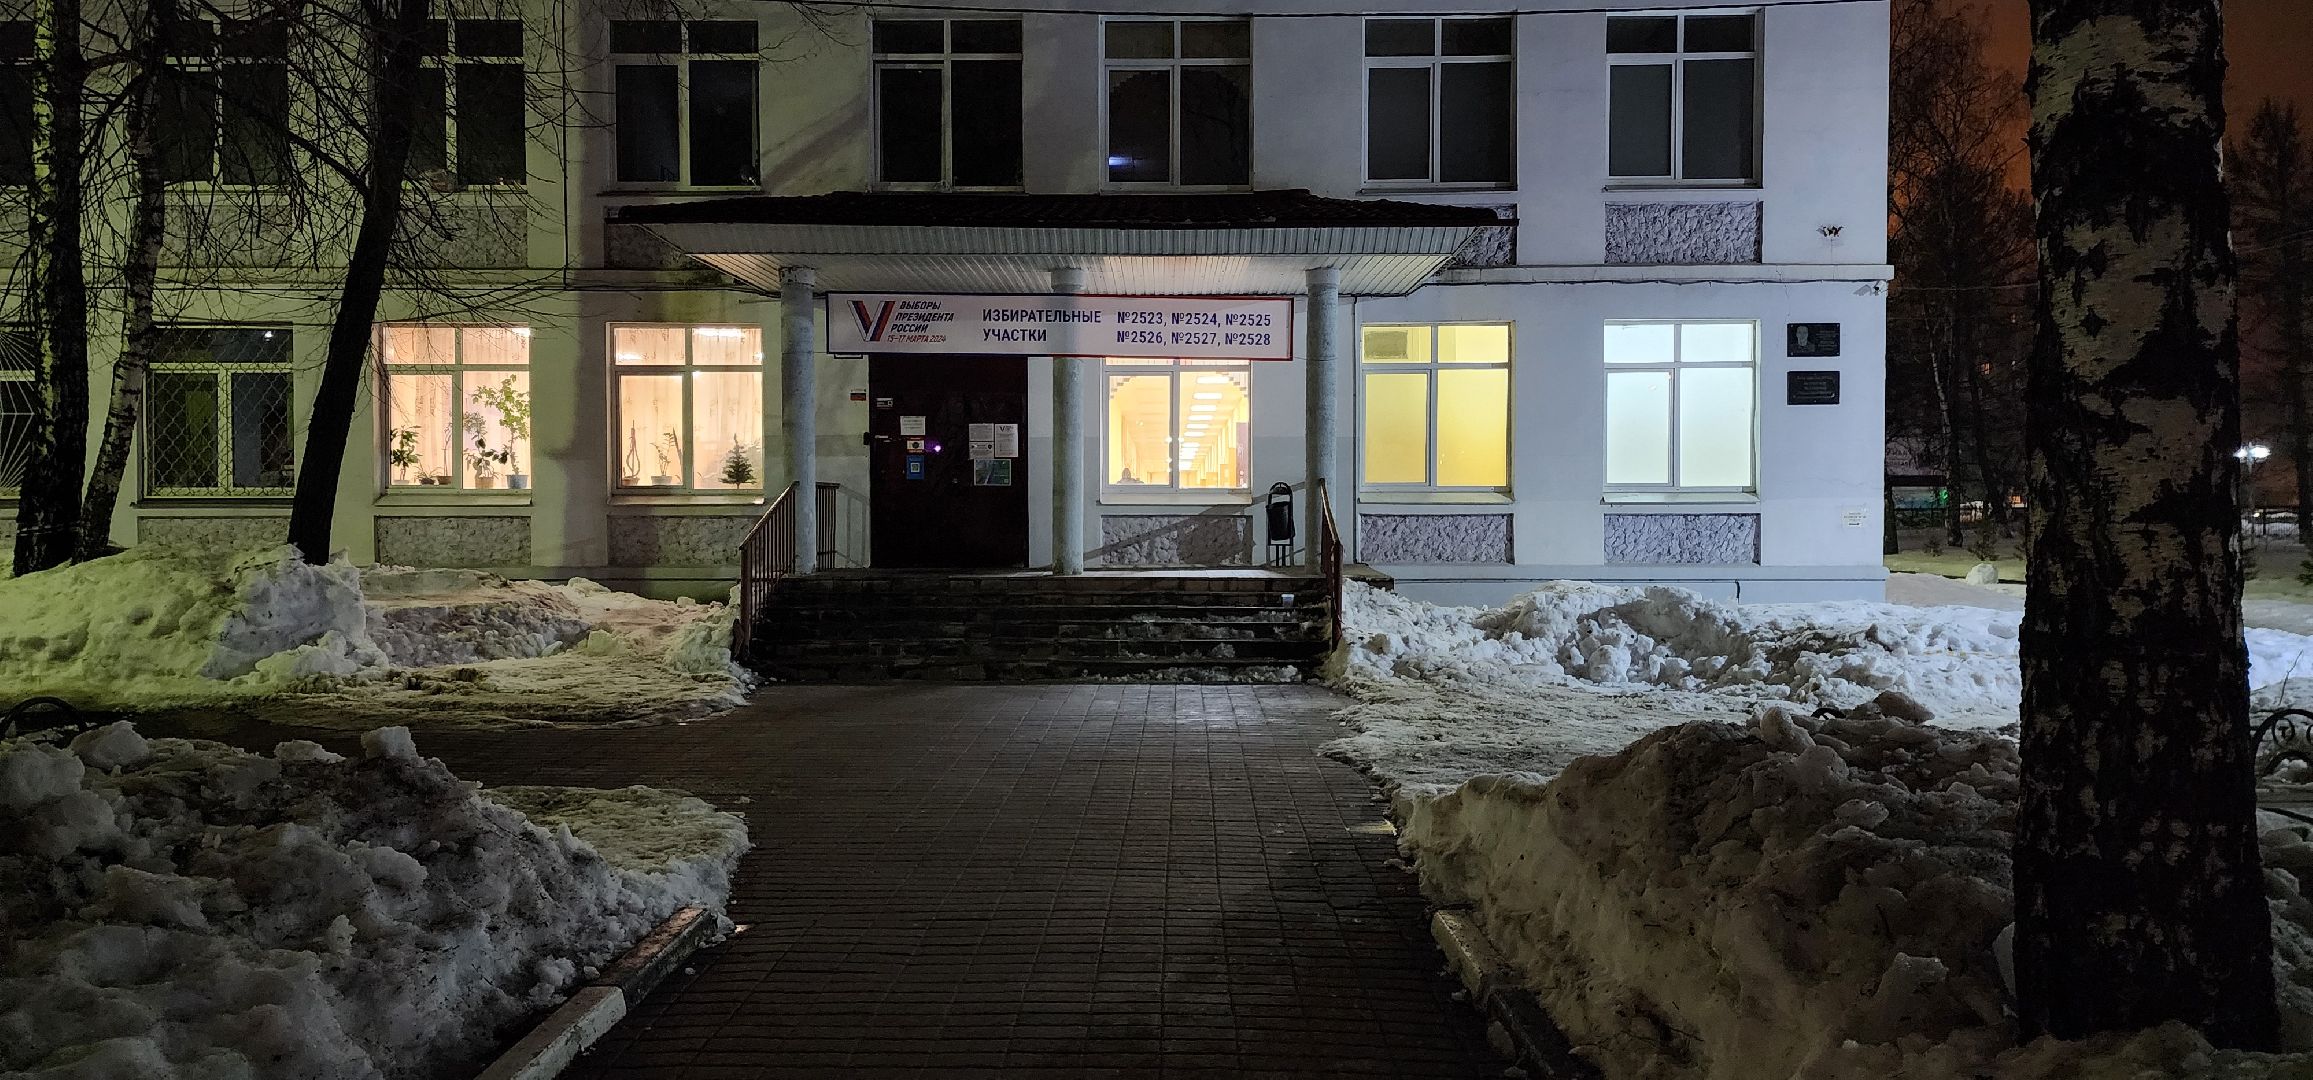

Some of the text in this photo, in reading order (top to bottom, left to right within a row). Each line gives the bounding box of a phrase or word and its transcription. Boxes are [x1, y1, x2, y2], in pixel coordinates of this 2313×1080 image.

[900, 301, 942, 310] ВЫБОРЫ
[895, 312, 954, 322] ПРЕЗИДЕНТА
[983, 309, 1271, 328] ИЗБИРАТЕЛЬНЫЕ №2523, №2524, №2525
[891, 323, 929, 333] РОССИИ
[929, 335, 946, 343] 2024
[983, 328, 1271, 347] УЧАСТКИ №2526, №2527, №2528
